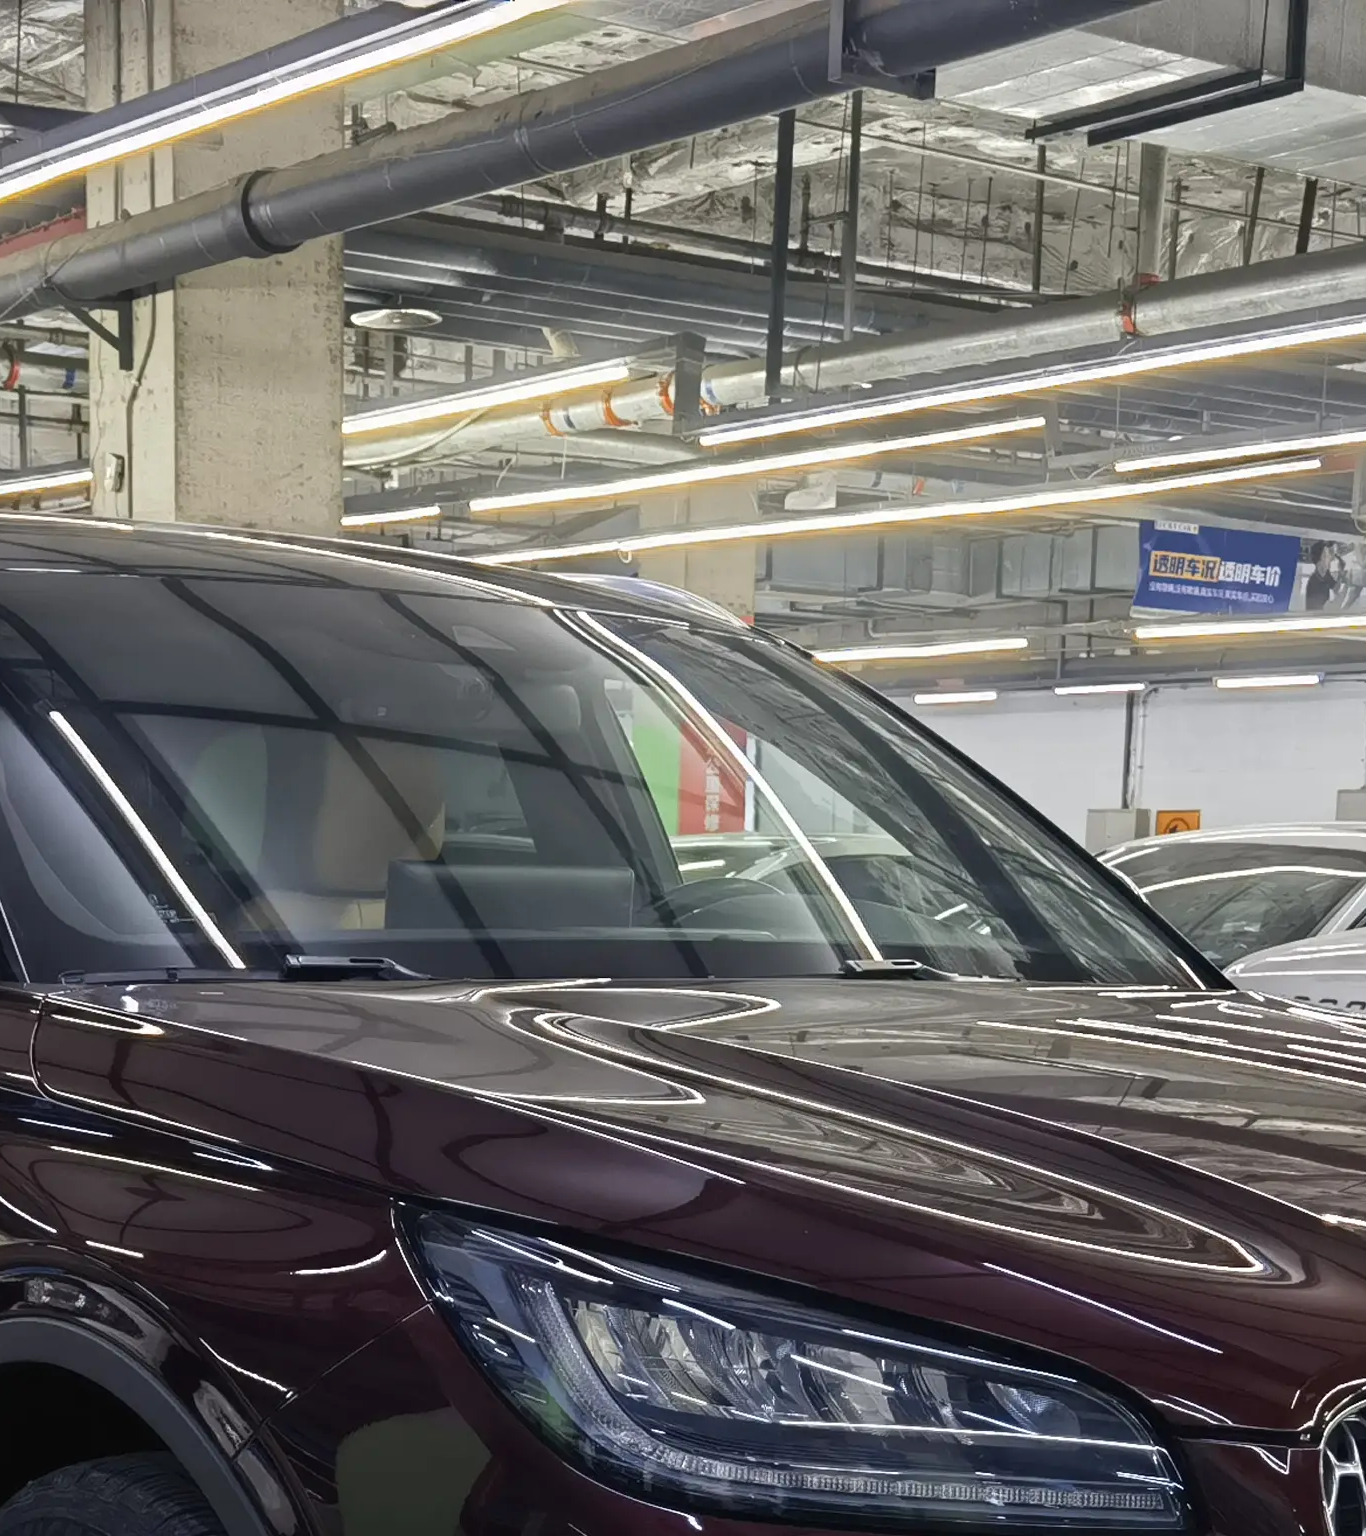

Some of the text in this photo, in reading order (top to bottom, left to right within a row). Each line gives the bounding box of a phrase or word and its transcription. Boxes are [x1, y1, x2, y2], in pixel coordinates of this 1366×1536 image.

[1152, 553, 1282, 587] 透明车况 透明车价
